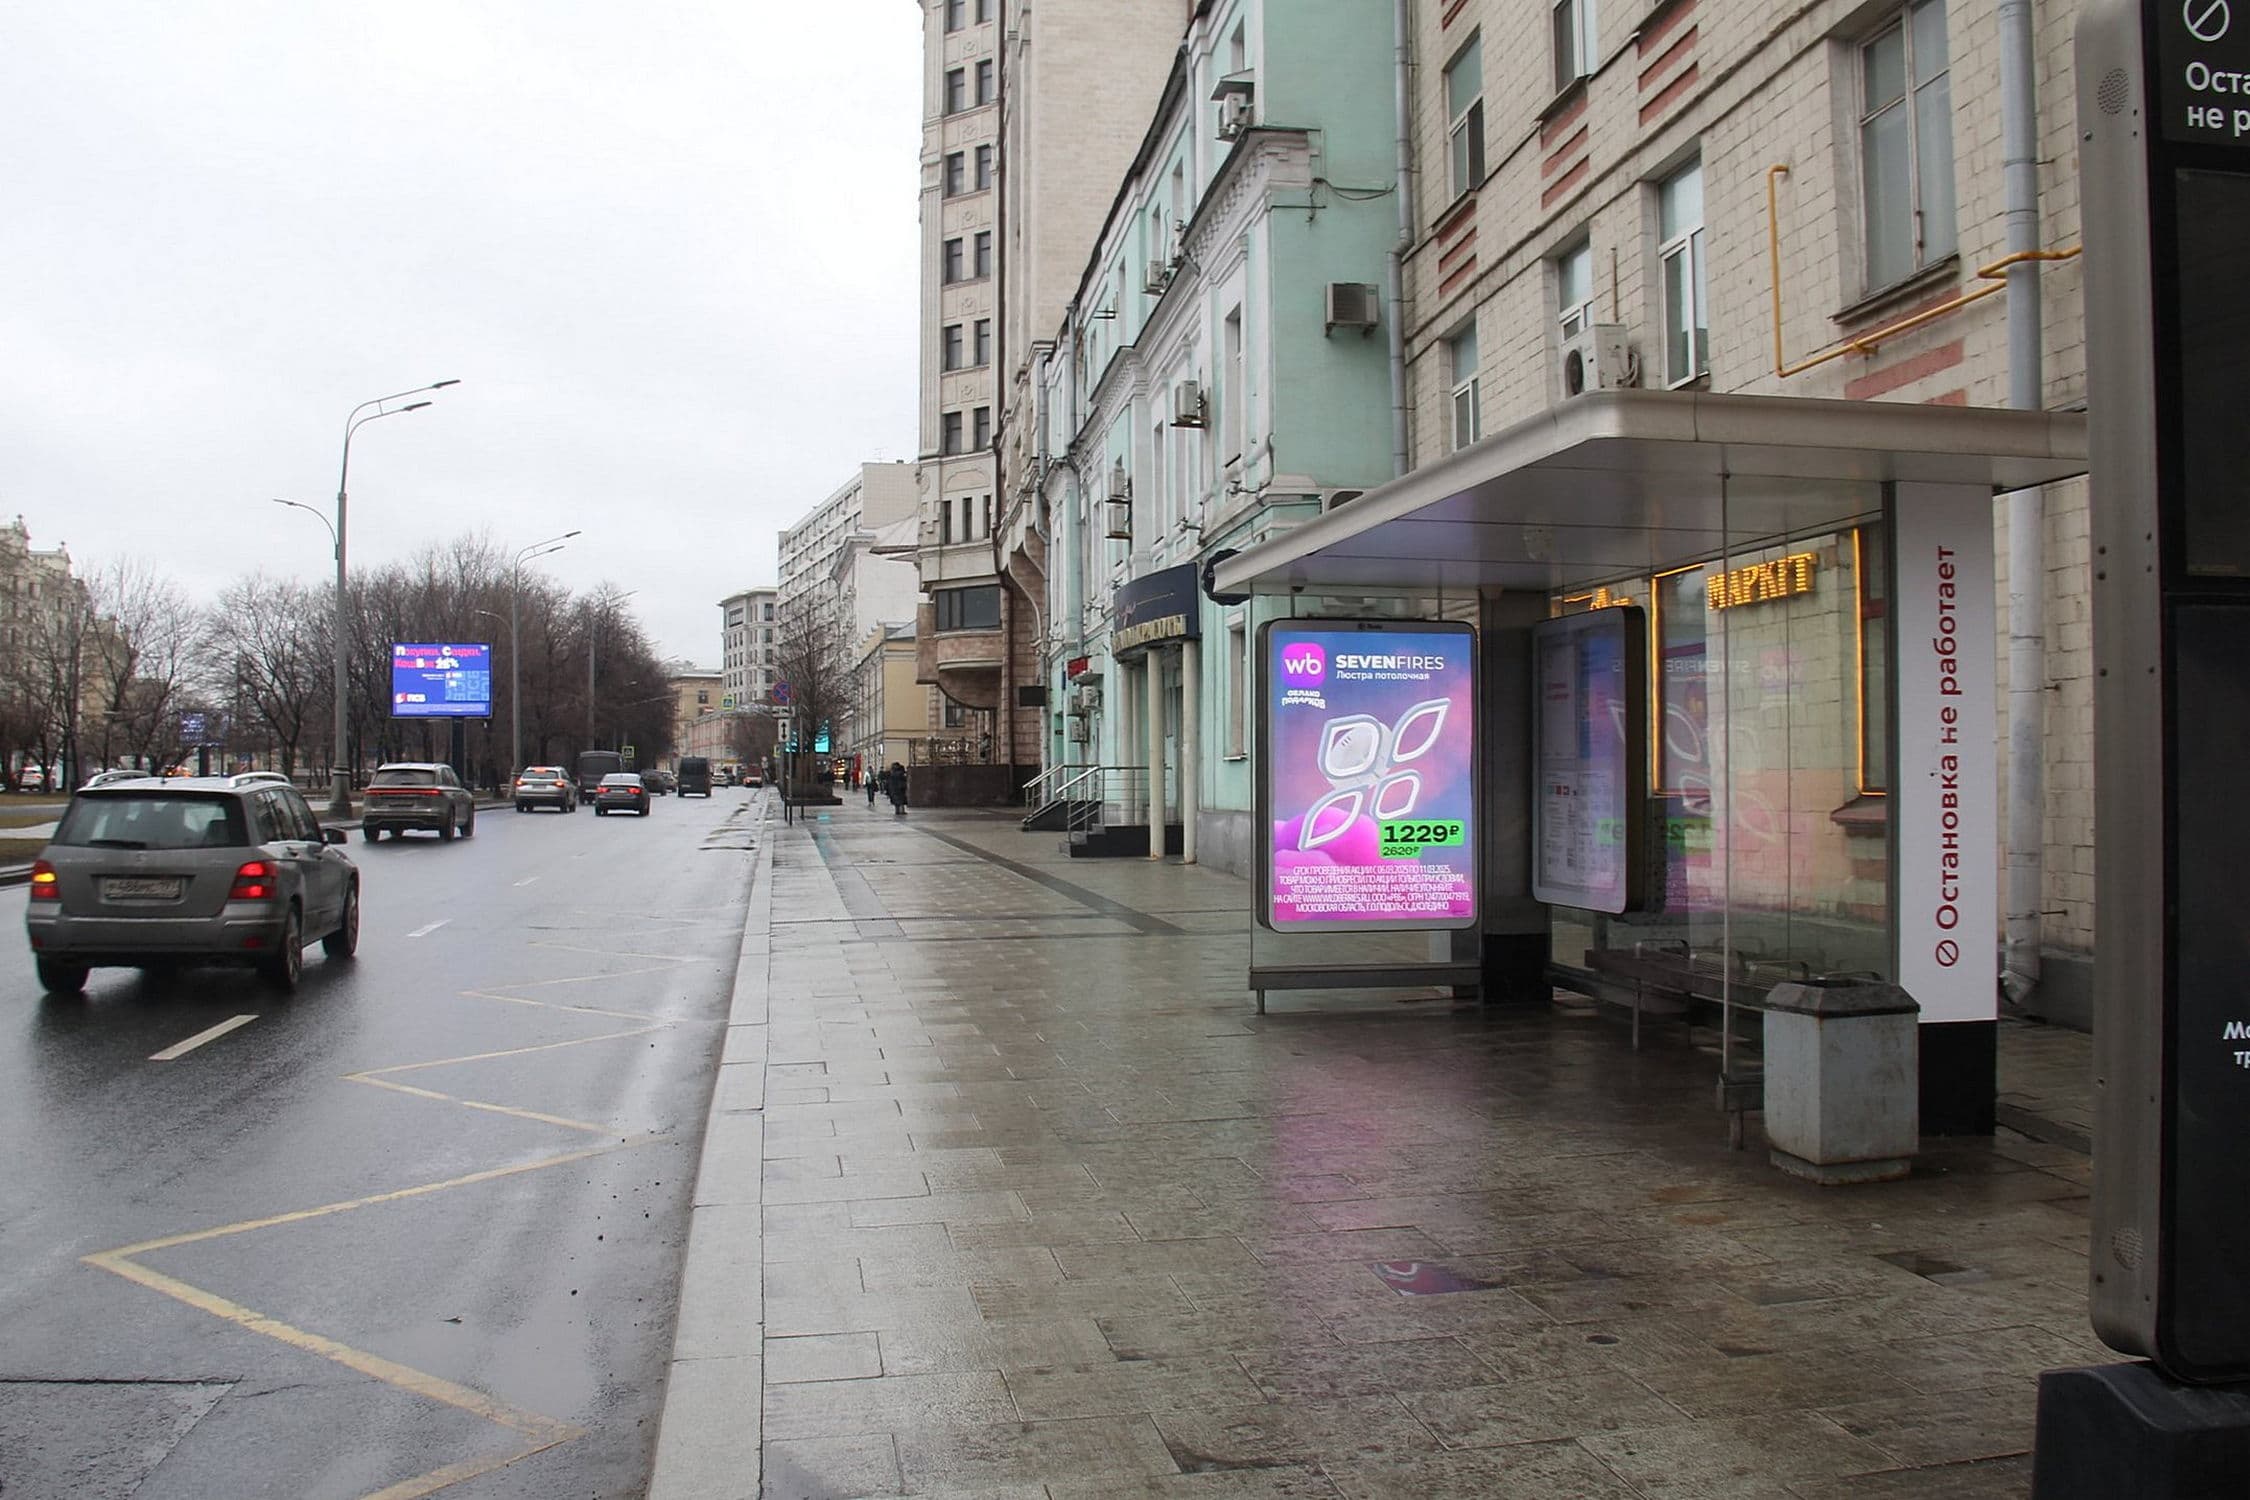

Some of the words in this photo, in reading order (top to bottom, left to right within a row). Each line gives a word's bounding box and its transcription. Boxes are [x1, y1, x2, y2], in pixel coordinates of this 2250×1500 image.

[2187, 106, 2224, 129] не
[1933, 545, 1962, 696] работает
[1285, 652, 1322, 675] wb
[1335, 655, 1444, 670] SEVENFIRES
[1336, 671, 1373, 681] Люстра
[1375, 673, 1430, 681] потолочная
[1941, 706, 1958, 744] не
[1936, 755, 1960, 930] Остановка
